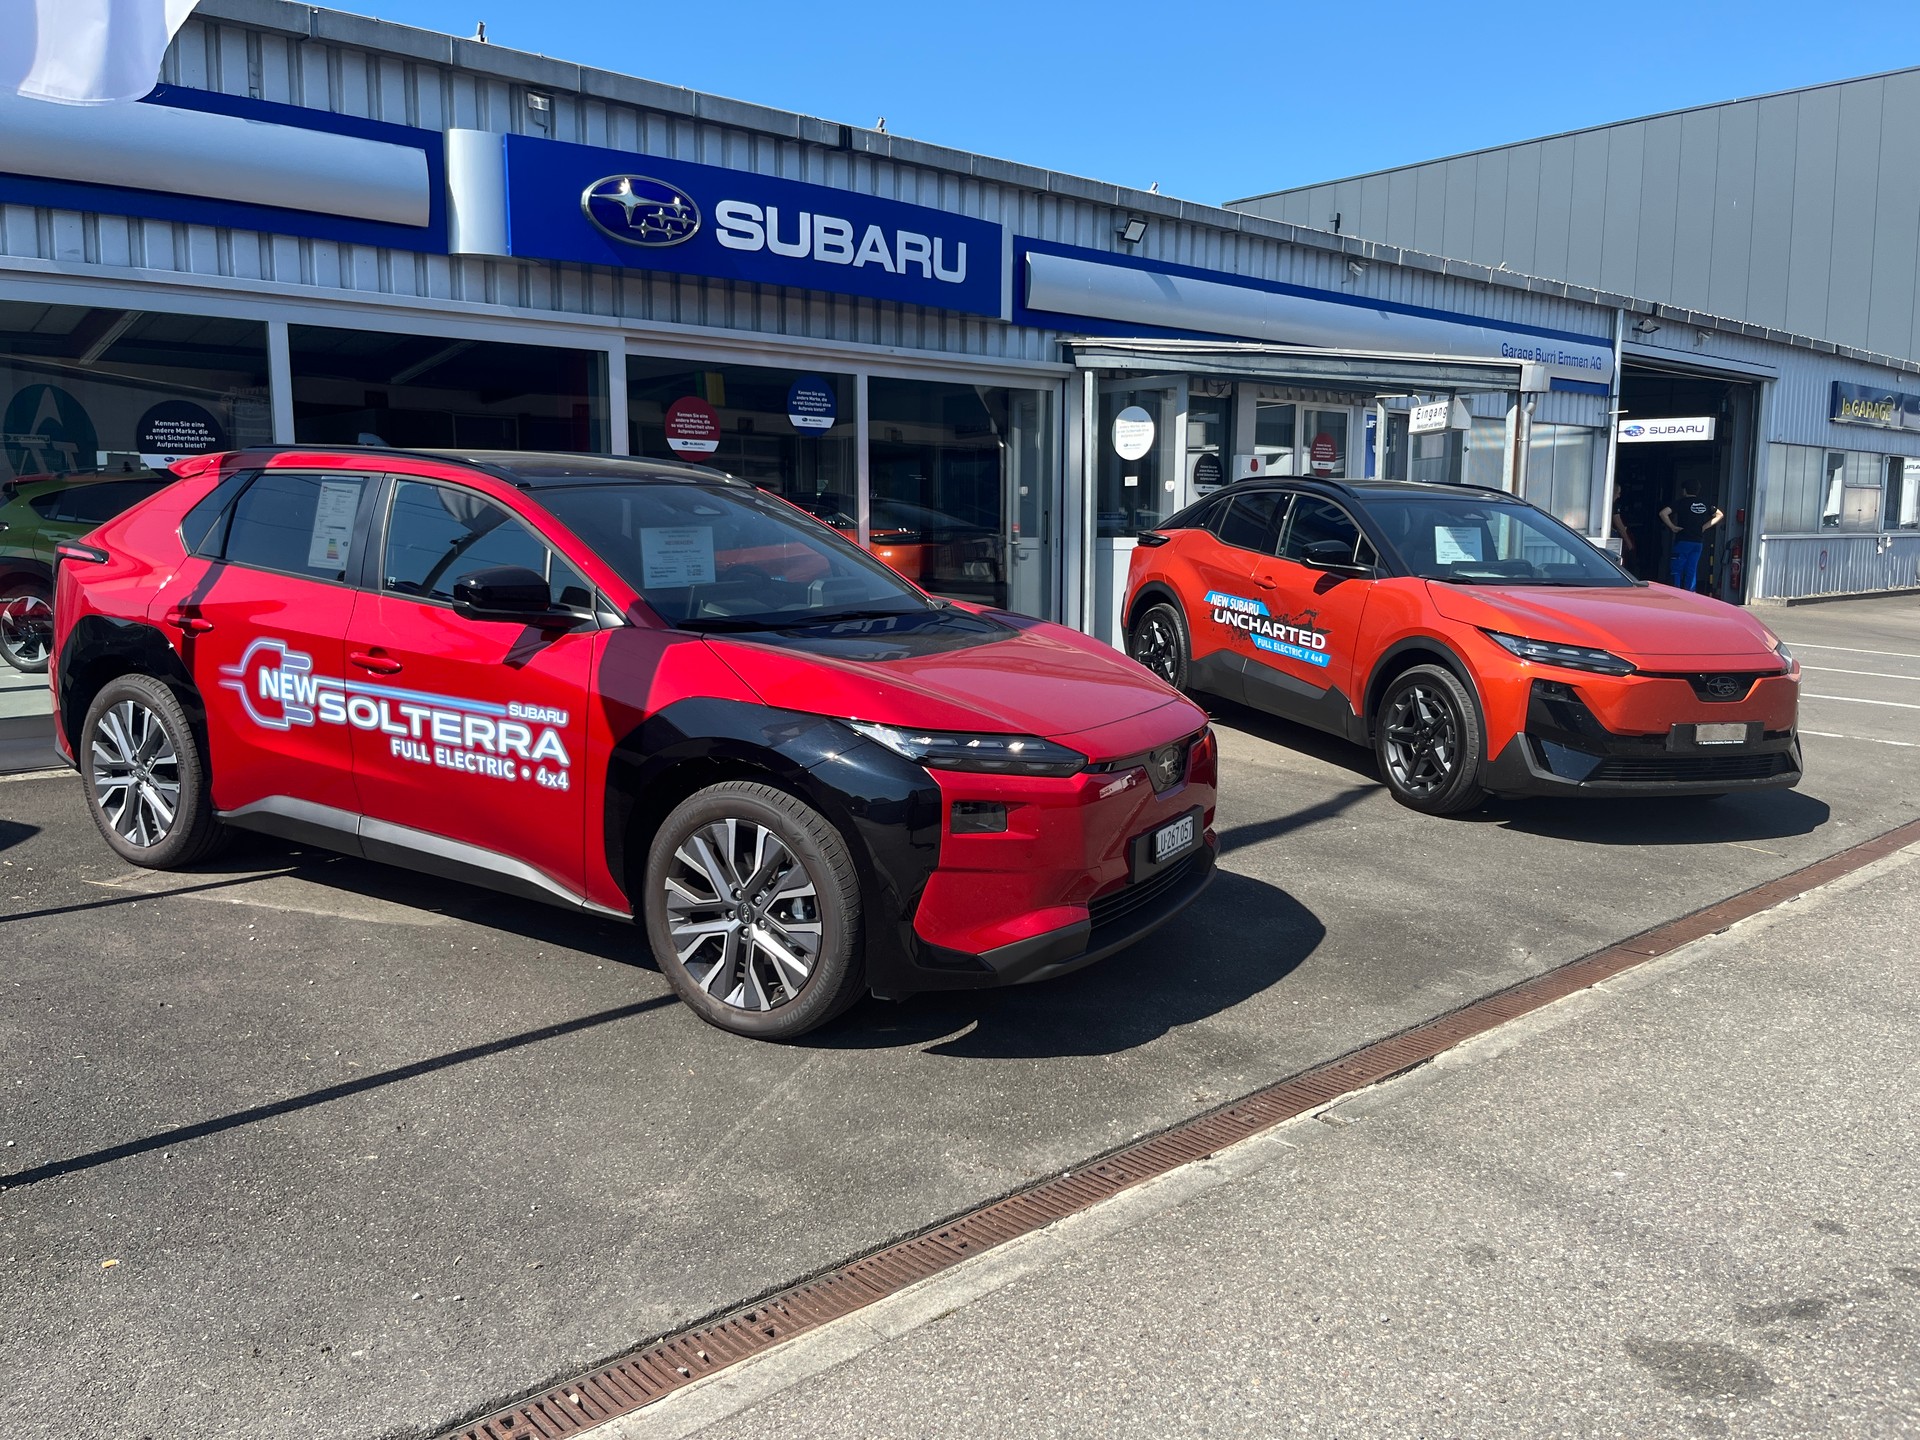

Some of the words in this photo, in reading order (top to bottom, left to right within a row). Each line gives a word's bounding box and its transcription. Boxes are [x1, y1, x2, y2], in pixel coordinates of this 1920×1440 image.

[715, 200, 967, 283] SUBARU
[1501, 343, 1533, 360] Garage
[1536, 347, 1556, 364] Burri
[1558, 351, 1588, 368] Emmen
[1590, 356, 1602, 370] AG
[1416, 406, 1448, 421] Eingang
[175, 428, 198, 436] Marke,
[1649, 425, 1705, 435] SUBARU
[156, 441, 184, 449] Aufpreis
[1210, 594, 1229, 607] NEW
[1230, 598, 1260, 616] SUBARU
[1213, 608, 1326, 650] UNCHARTED
[1257, 638, 1273, 649] FULL
[1273, 641, 1303, 657] ELECTRIC
[1310, 654, 1323, 663] 4x4
[260, 668, 317, 704] NEW
[508, 704, 567, 725] SUBARU
[319, 693, 570, 766] SOLTERRA
[391, 739, 431, 763] FULL
[436, 749, 516, 780] ELECTRIC
[536, 768, 569, 790] 4x4
